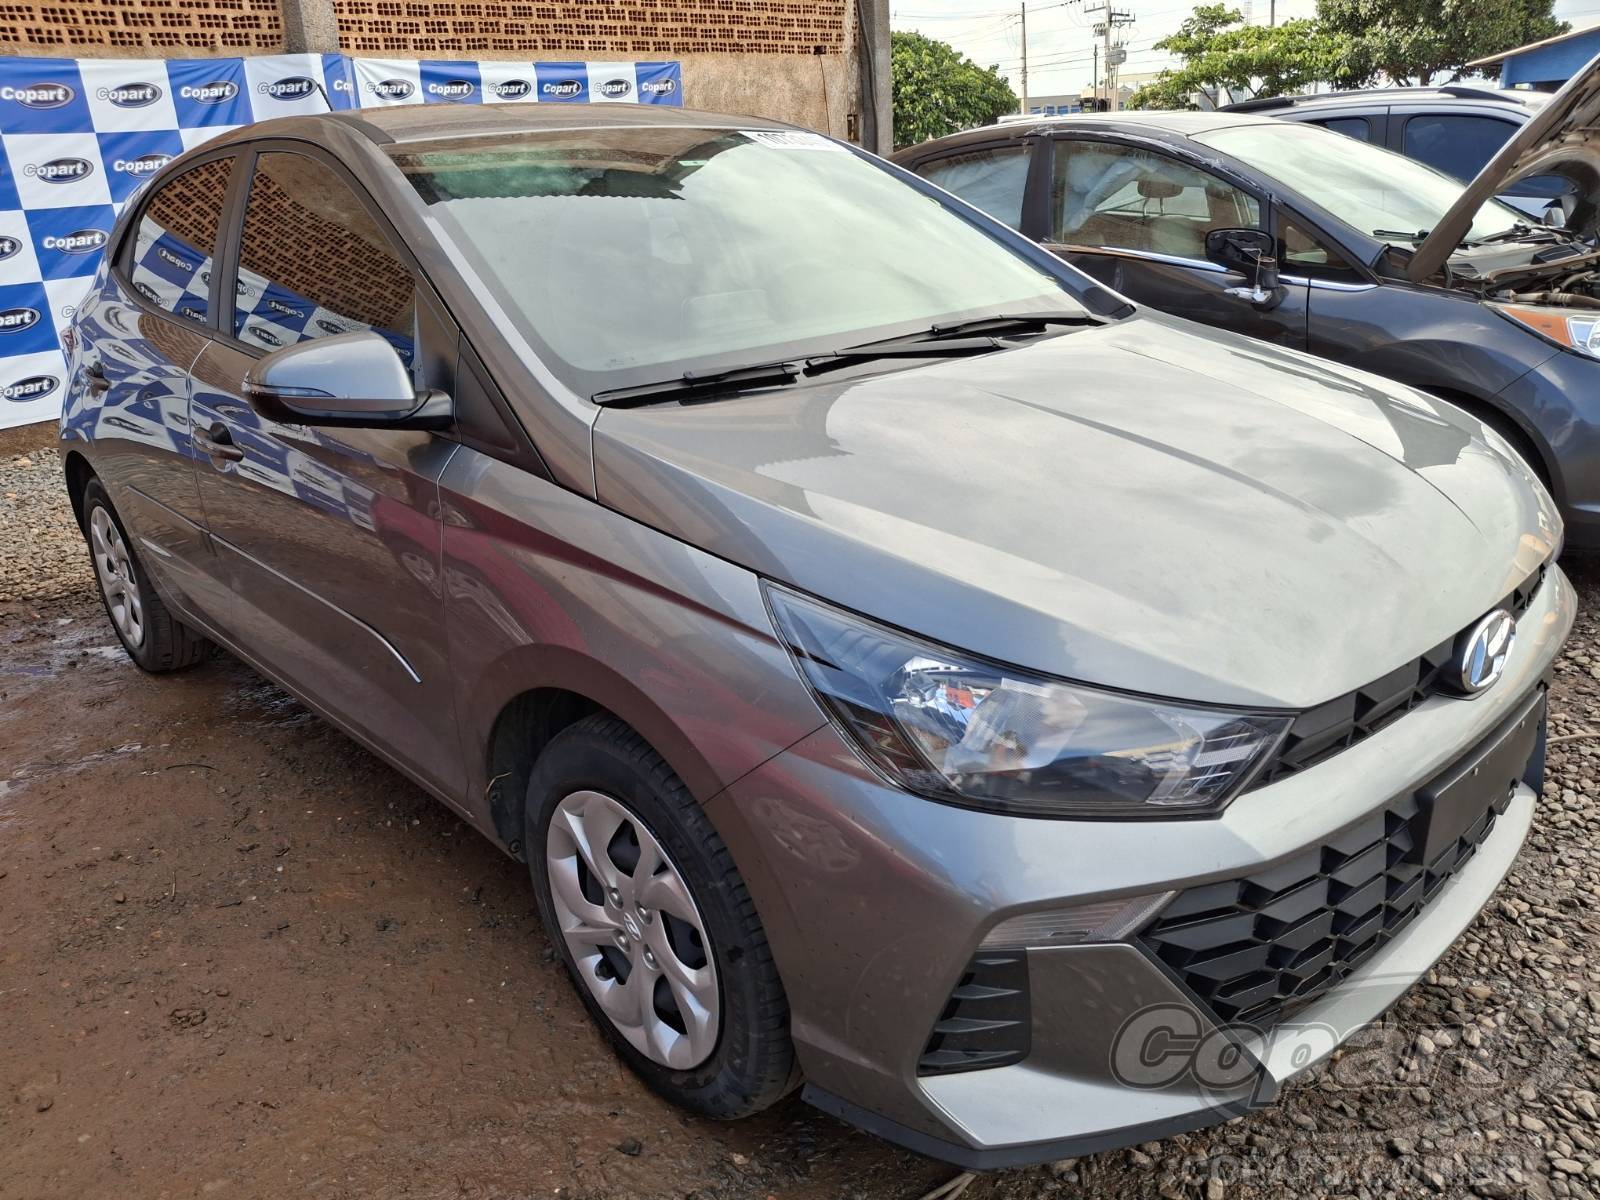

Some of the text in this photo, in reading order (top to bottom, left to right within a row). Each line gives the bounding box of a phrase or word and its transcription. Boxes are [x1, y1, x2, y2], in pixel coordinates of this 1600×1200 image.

[181, 85, 233, 100] Copart
[257, 80, 310, 97] Copart
[365, 81, 409, 94] Copart
[428, 82, 469, 94] Copart
[488, 82, 526, 94] Copart
[543, 83, 579, 95] Copart
[594, 82, 626, 95] Copart
[641, 81, 673, 94] Copart
[1, 87, 67, 103] Copart
[96, 87, 154, 103] Copart
[23, 161, 86, 179] Copart
[42, 232, 102, 250] Copart
